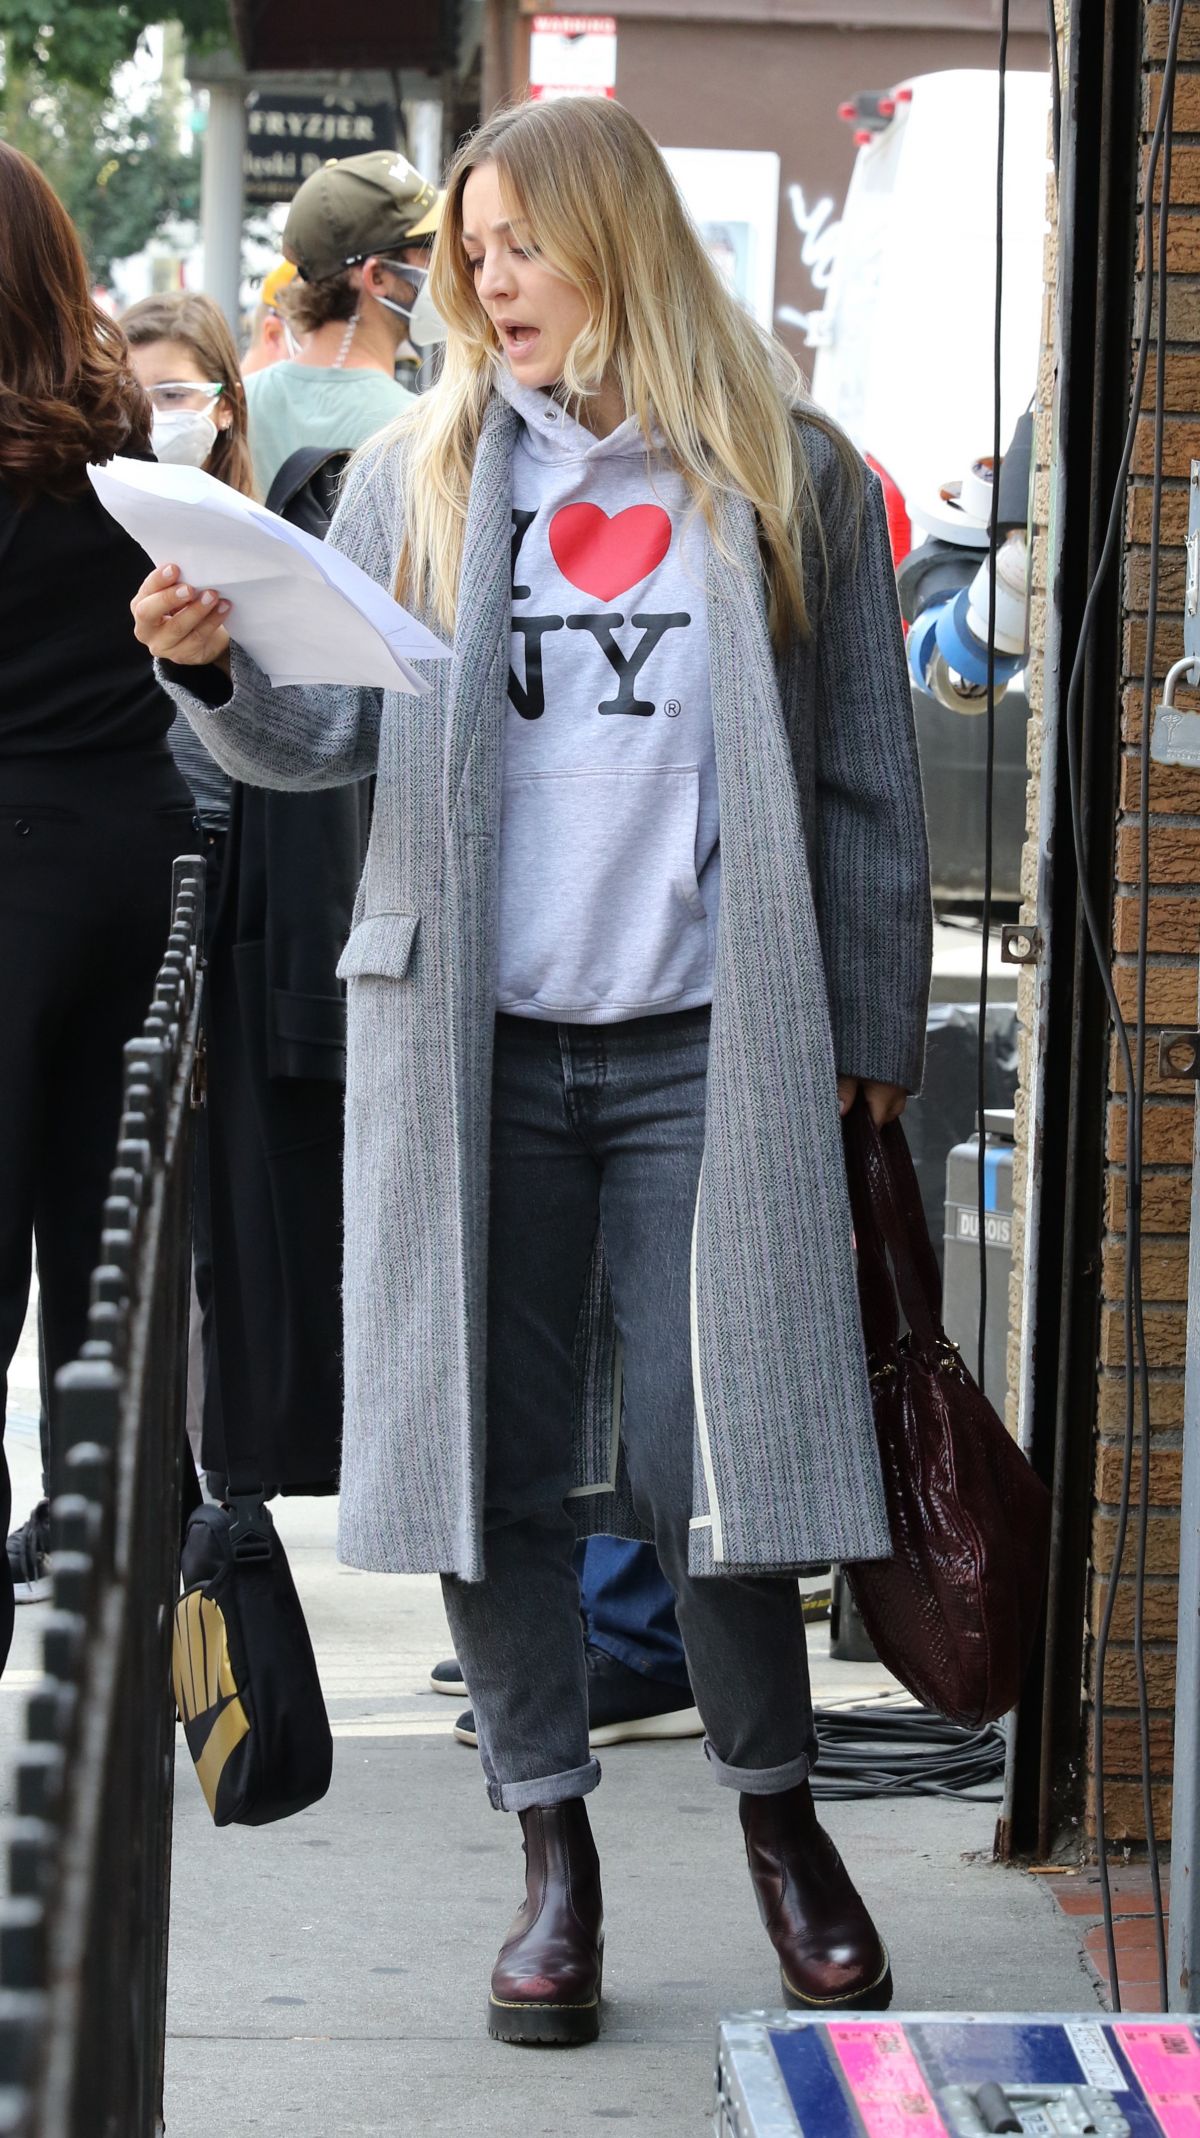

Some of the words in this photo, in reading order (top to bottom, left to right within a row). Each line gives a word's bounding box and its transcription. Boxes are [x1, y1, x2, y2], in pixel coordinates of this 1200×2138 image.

[249, 111, 375, 143] FRYZJER
[507, 612, 692, 721] NY
[960, 1212, 1011, 1243] DUOIS
